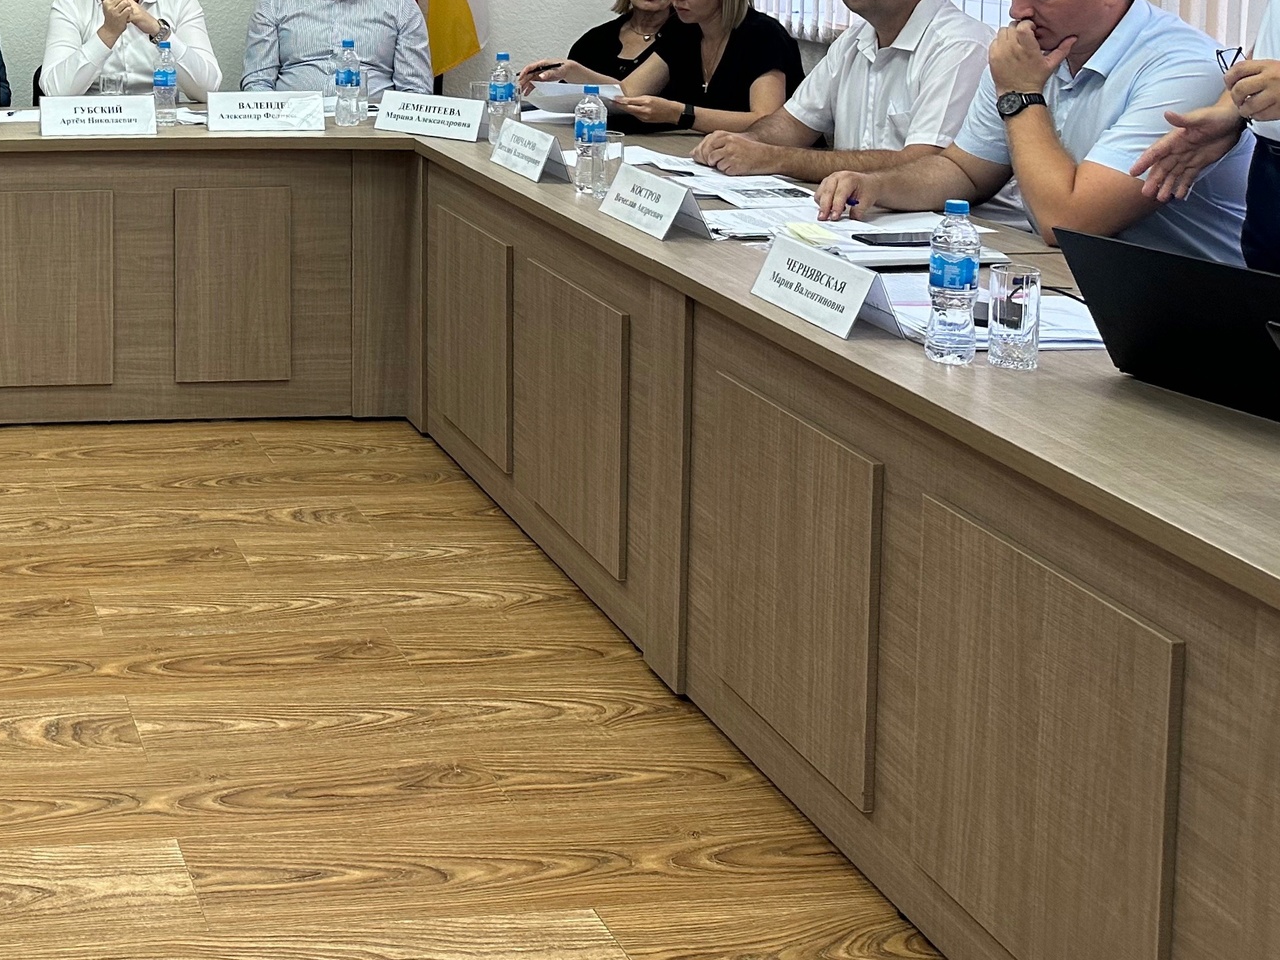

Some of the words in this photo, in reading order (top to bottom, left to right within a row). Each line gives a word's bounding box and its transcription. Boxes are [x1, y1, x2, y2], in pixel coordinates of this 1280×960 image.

[73, 105, 123, 115] ГУБСКИЙ
[219, 113, 262, 121] Александр
[398, 102, 461, 117] ДЕМЕНТЕЕВА
[60, 117, 86, 126] Артём
[385, 112, 414, 122] Марина
[415, 115, 471, 129] Александровна
[630, 183, 662, 204] КОСТРОВ
[786, 257, 847, 294] ЧЕРНЯВСКАЯ
[770, 270, 794, 289] Мария
[793, 281, 846, 314] Валентиновна
